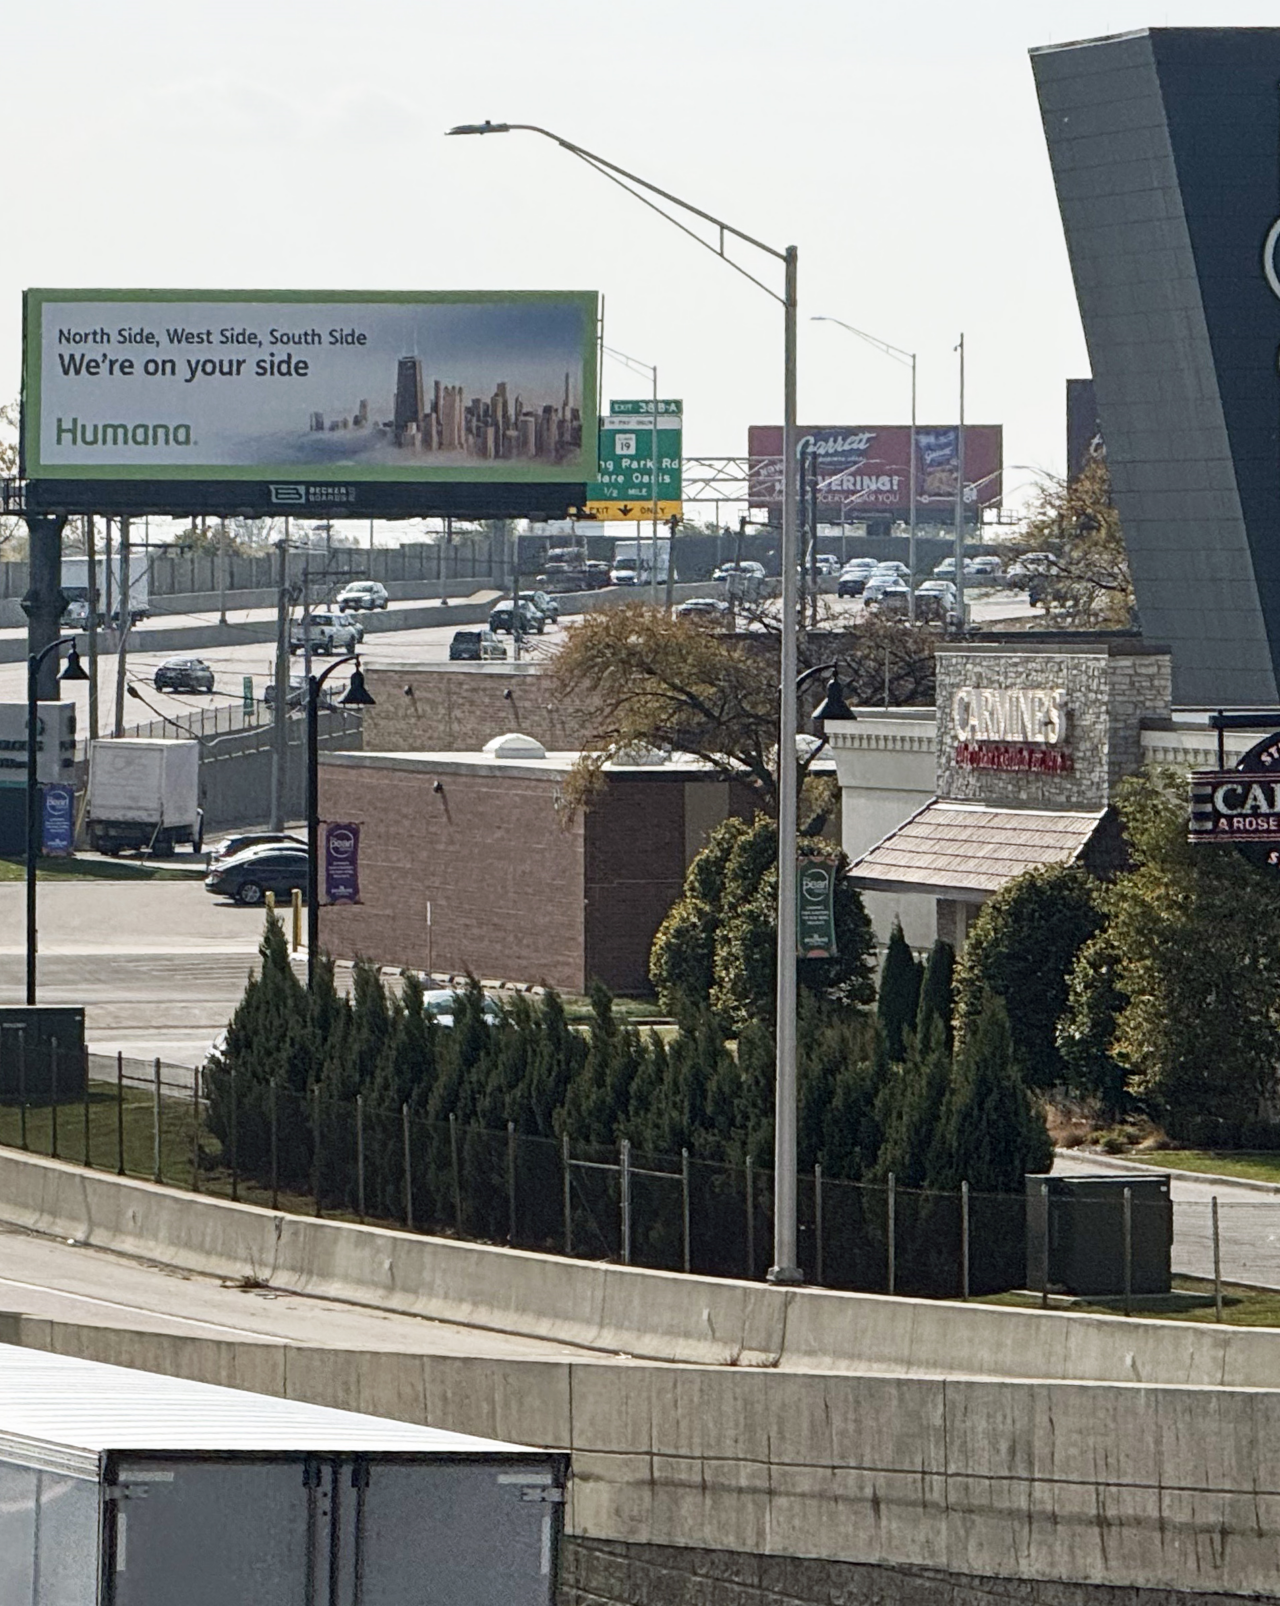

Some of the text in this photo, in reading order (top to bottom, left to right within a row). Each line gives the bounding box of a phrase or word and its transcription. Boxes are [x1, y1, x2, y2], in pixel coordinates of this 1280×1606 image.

[58, 327, 368, 348] North Side, West Side, South Side
[58, 352, 309, 383] We’re on your side
[614, 404, 632, 412] EXIT
[56, 417, 192, 446] Humana
[620, 442, 631, 451] 19
[797, 431, 876, 459] Garrett
[621, 459, 654, 469] Park
[662, 459, 679, 469] Rd
[628, 488, 647, 496] MILE
[878, 494, 900, 504] YOU
[589, 506, 609, 514] EXIT
[1218, 818, 1229, 831] A
